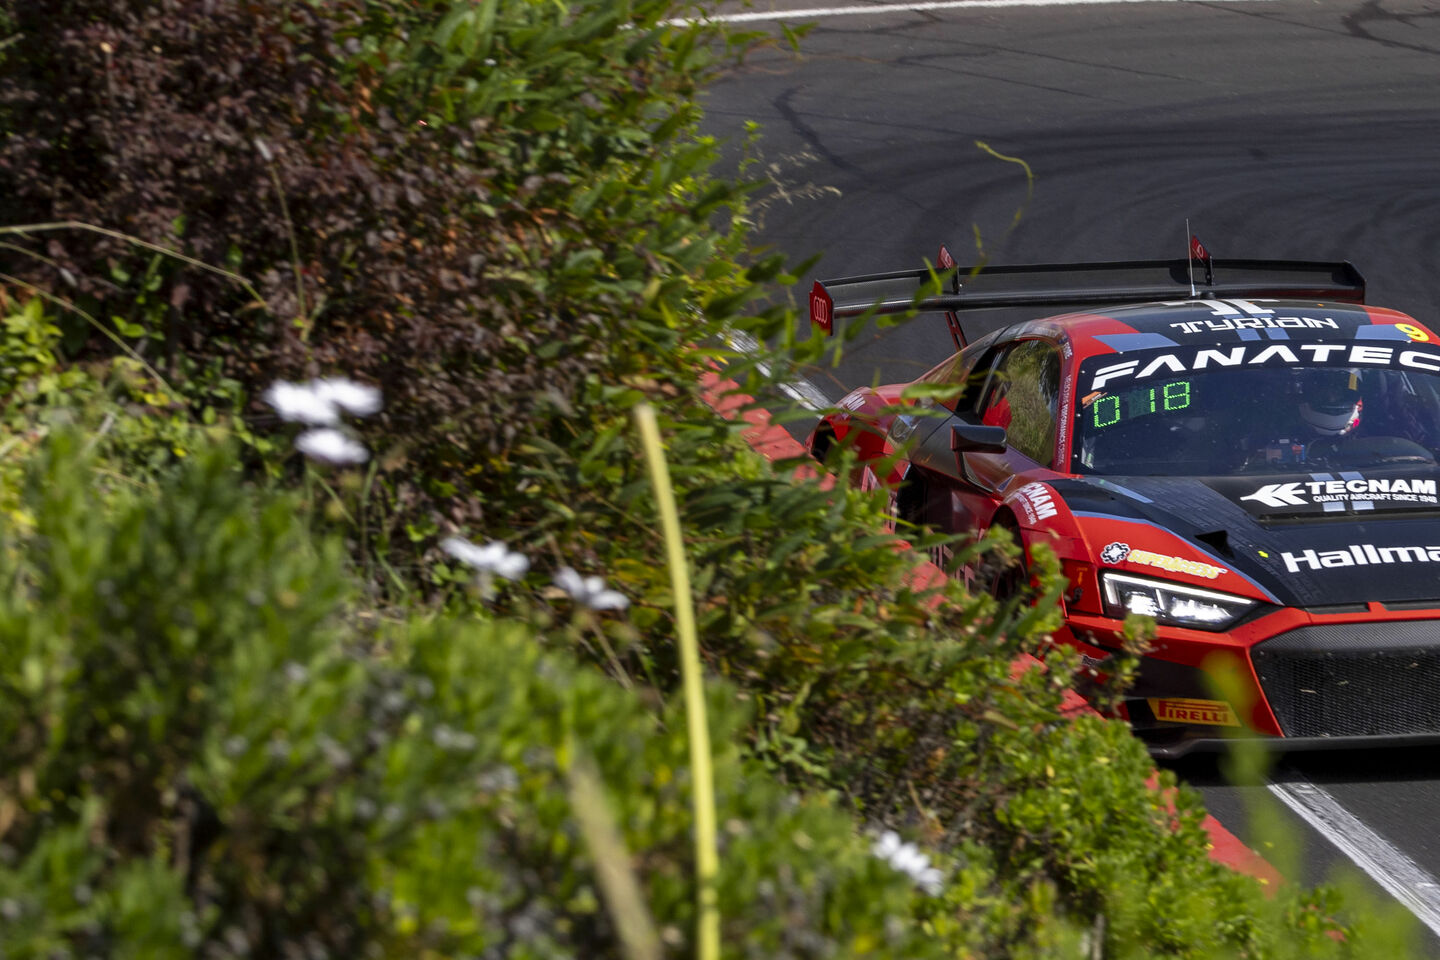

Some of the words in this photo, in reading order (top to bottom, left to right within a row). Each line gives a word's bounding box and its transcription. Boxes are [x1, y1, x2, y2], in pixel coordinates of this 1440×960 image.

[1394, 323, 1430, 342] 9
[1305, 479, 1437, 495] TECNAM
[1313, 494, 1349, 503] QUALITY
[1350, 493, 1391, 501] AIRCRAFT
[1392, 494, 1419, 502] SINCE
[1159, 700, 1228, 723] PIRELLI
